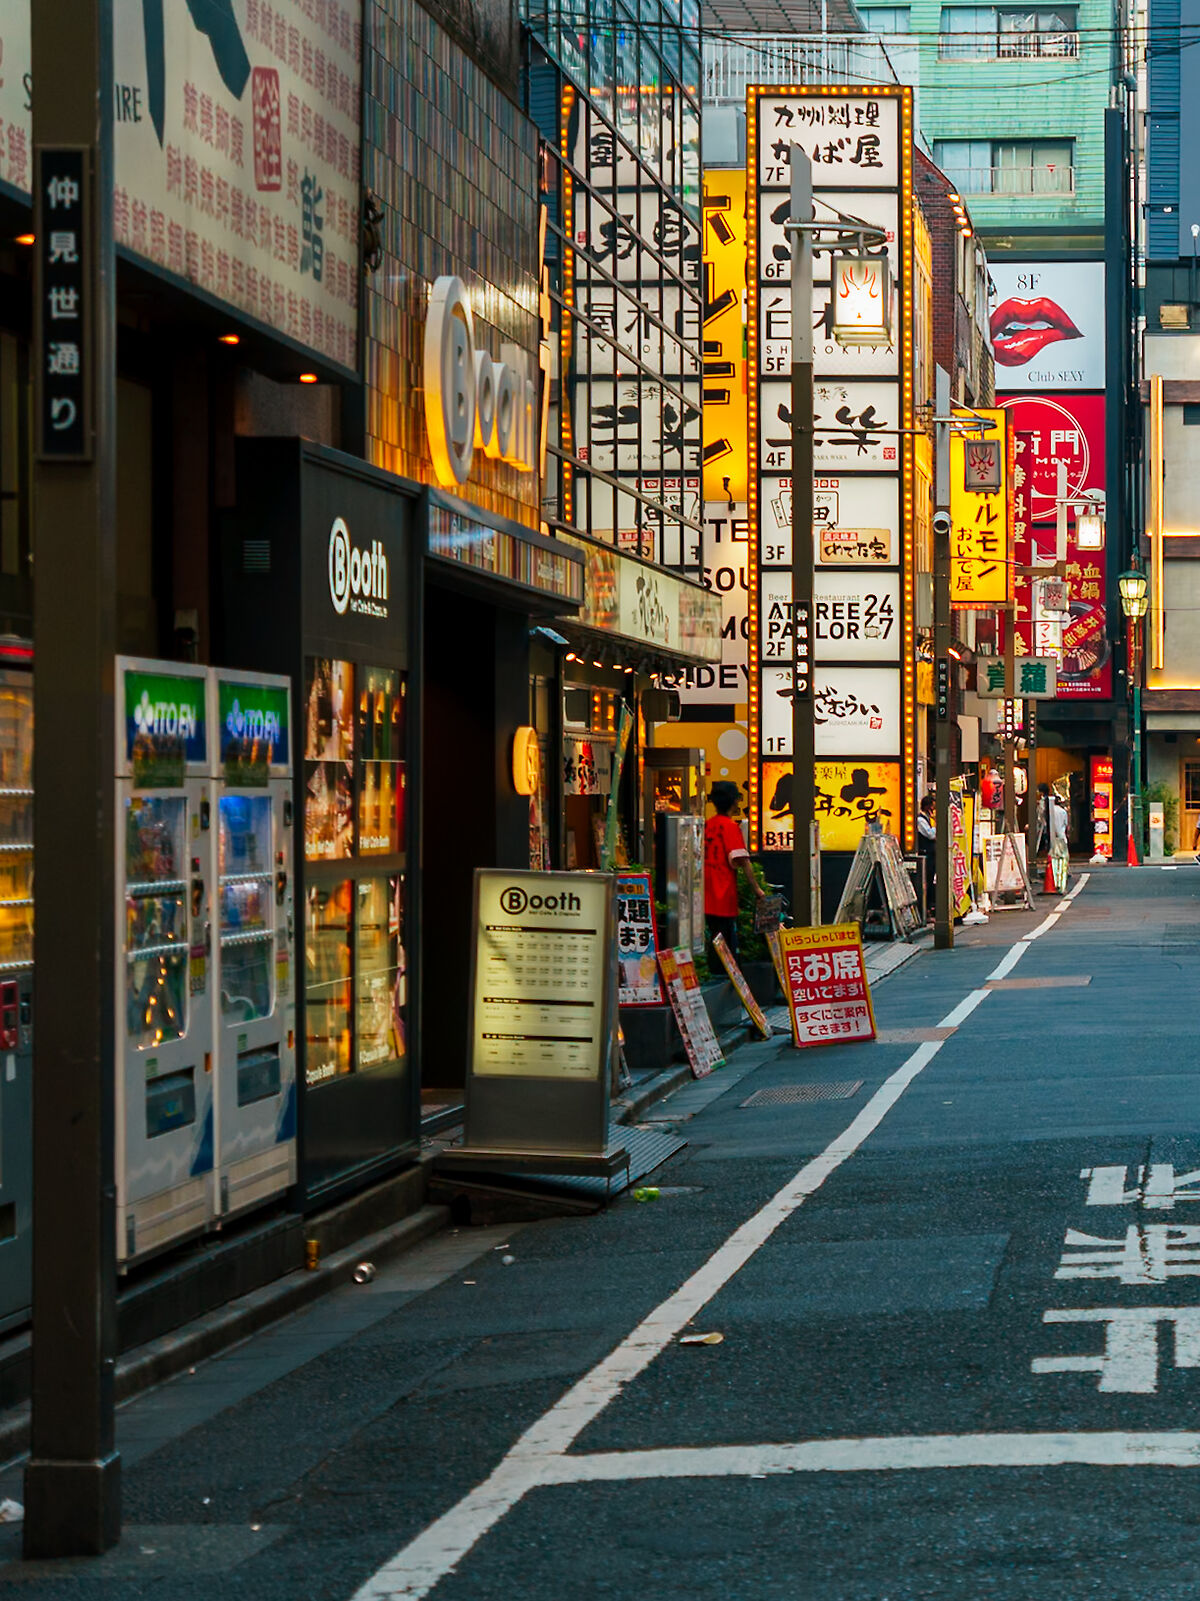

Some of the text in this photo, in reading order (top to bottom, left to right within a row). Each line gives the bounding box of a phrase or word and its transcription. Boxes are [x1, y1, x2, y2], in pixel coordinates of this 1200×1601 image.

[773, 102, 881, 128] 九州料理
[765, 167, 785, 181] 7F
[765, 263, 785, 278] 6F
[1017, 273, 1041, 290] 8F
[47, 175, 79, 430] 仲見世通り
[766, 357, 785, 371] 5F
[1028, 370, 1085, 382] Club SEXY
[766, 452, 786, 466] 4F
[766, 546, 785, 560] 3F
[957, 527, 974, 592] おいで屋
[328, 516, 388, 615] Booth
[766, 641, 785, 656] 2F
[154, 701, 196, 739] ITO EN
[243, 709, 264, 740] ITO
[767, 737, 785, 752] 1F
[500, 887, 581, 915] Booth
[785, 930, 857, 946] いらっしゃいませ
[788, 955, 804, 984] 只今
[803, 950, 862, 982] お席
[798, 1005, 867, 1024] すぐにご案内
